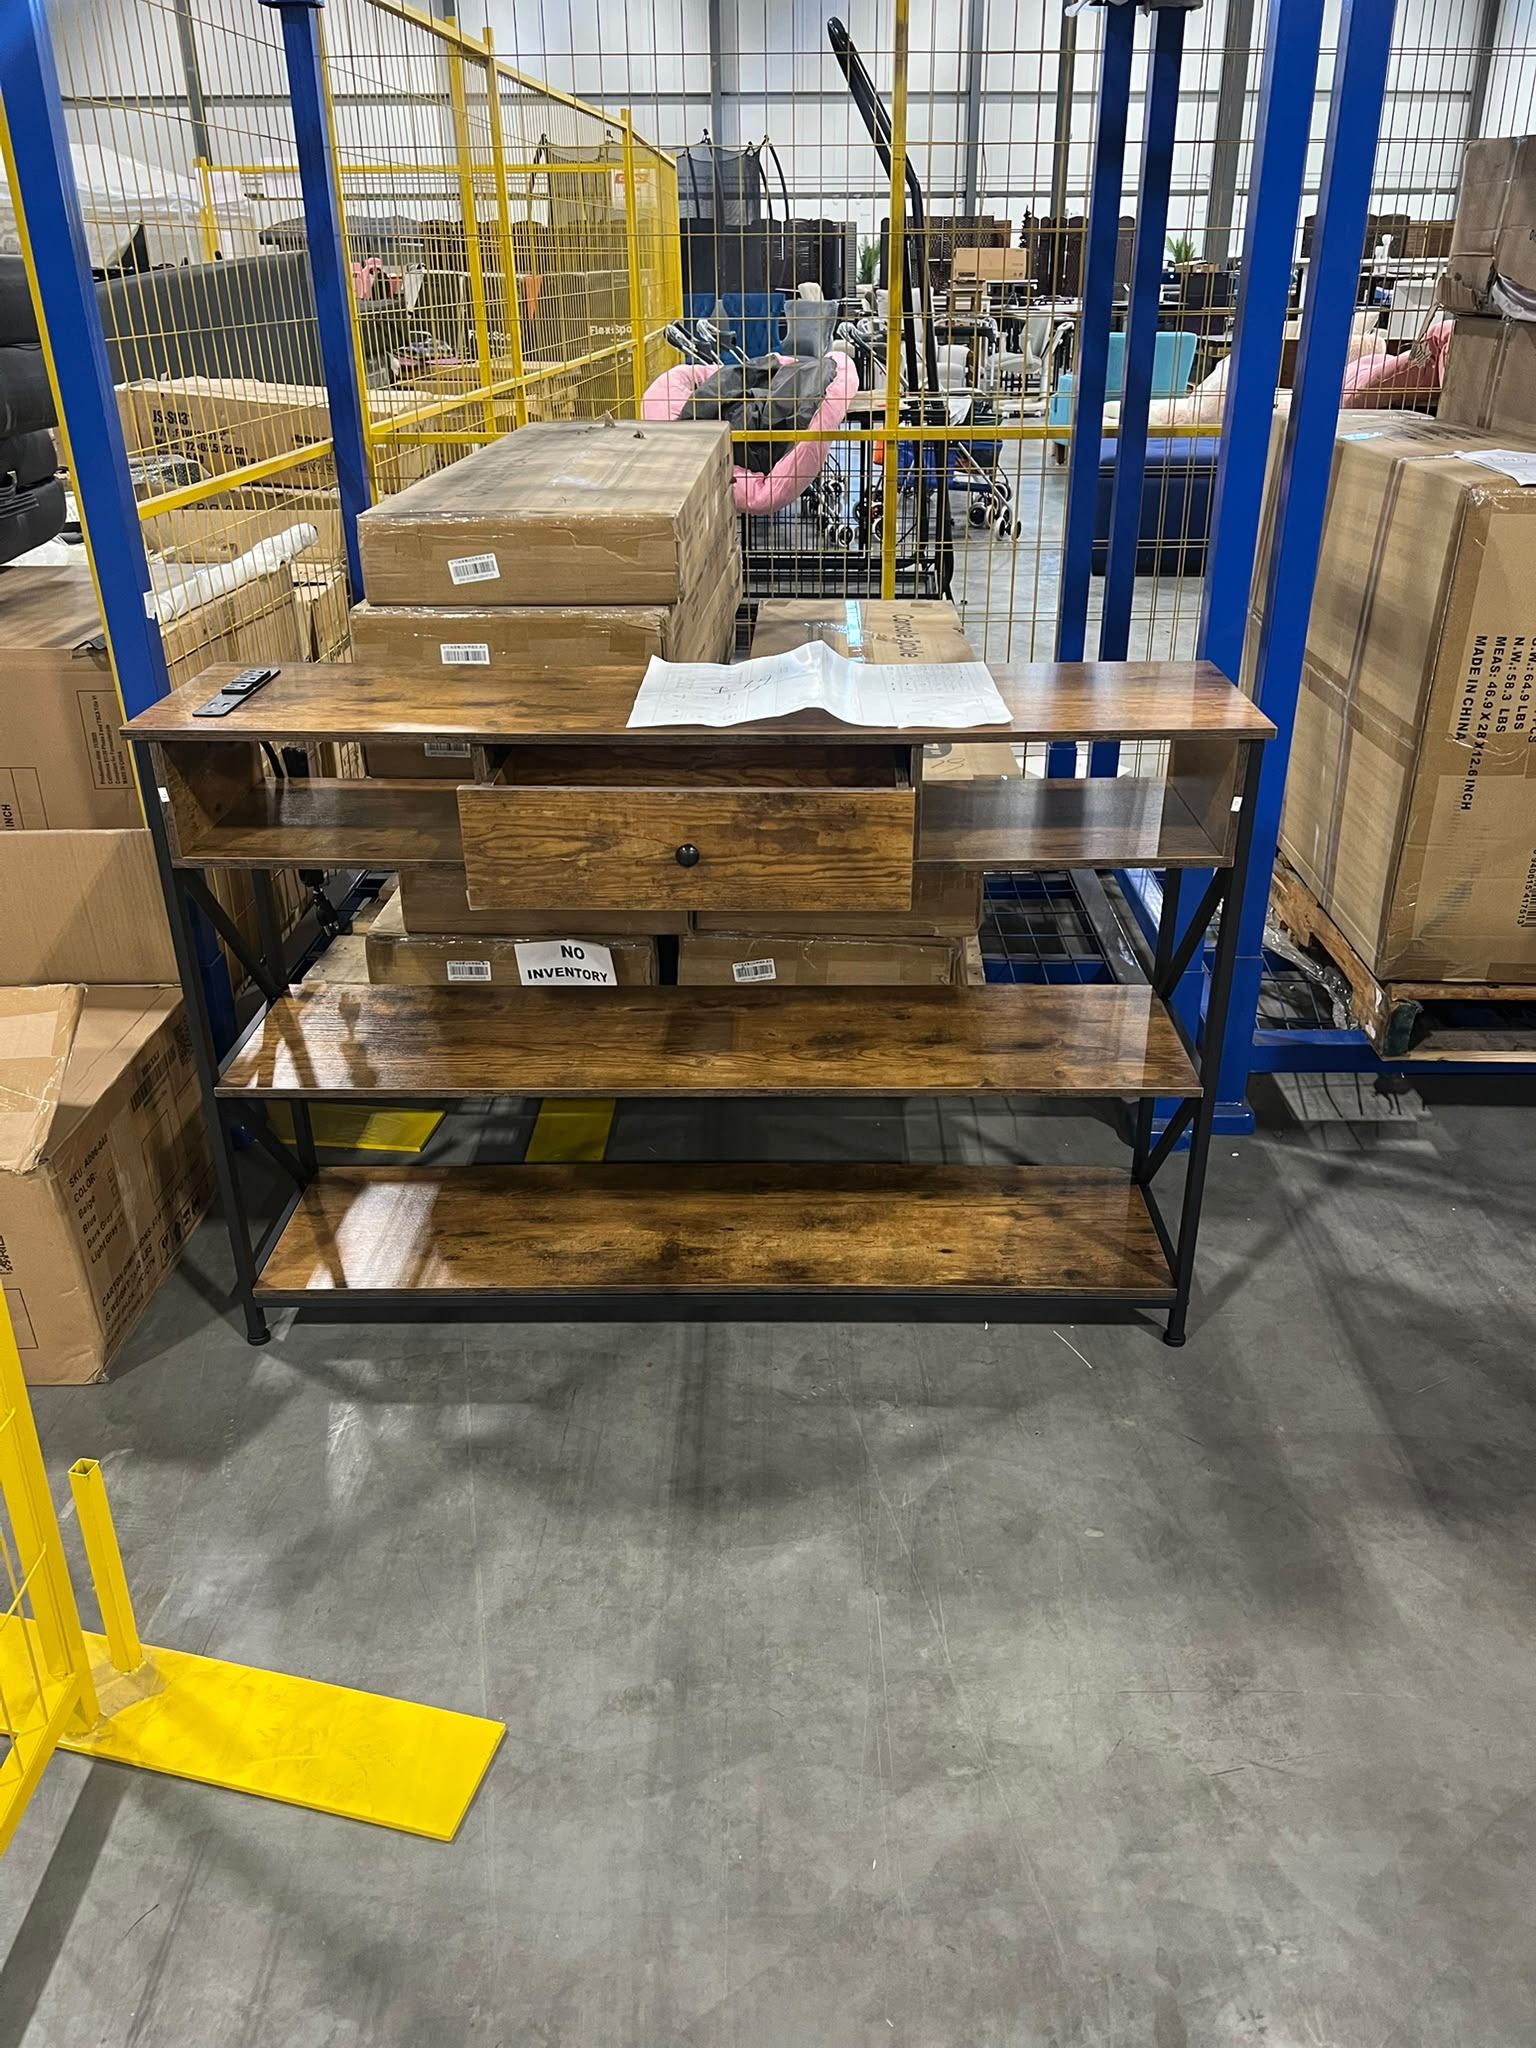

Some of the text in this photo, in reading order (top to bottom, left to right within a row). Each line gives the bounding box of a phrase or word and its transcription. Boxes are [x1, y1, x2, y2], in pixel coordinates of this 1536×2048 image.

[1488, 636, 1508, 677] MEAS:
[1455, 635, 1488, 741] MADE IN CHINA
[1482, 681, 1497, 709] 46.9
[1495, 637, 1525, 733] N.W.: 58.3 LBS
[1520, 673, 1534, 701] 64.9
[1514, 705, 1528, 730] LBS
[1476, 723, 1489, 739] 28
[1460, 779, 1475, 810] INCH
[1, 804, 15, 828] INCH
[560, 944, 585, 960] NO
[527, 967, 608, 983] INVENTORY
[78, 1195, 96, 1219] Beige
[82, 1213, 97, 1234] Blue
